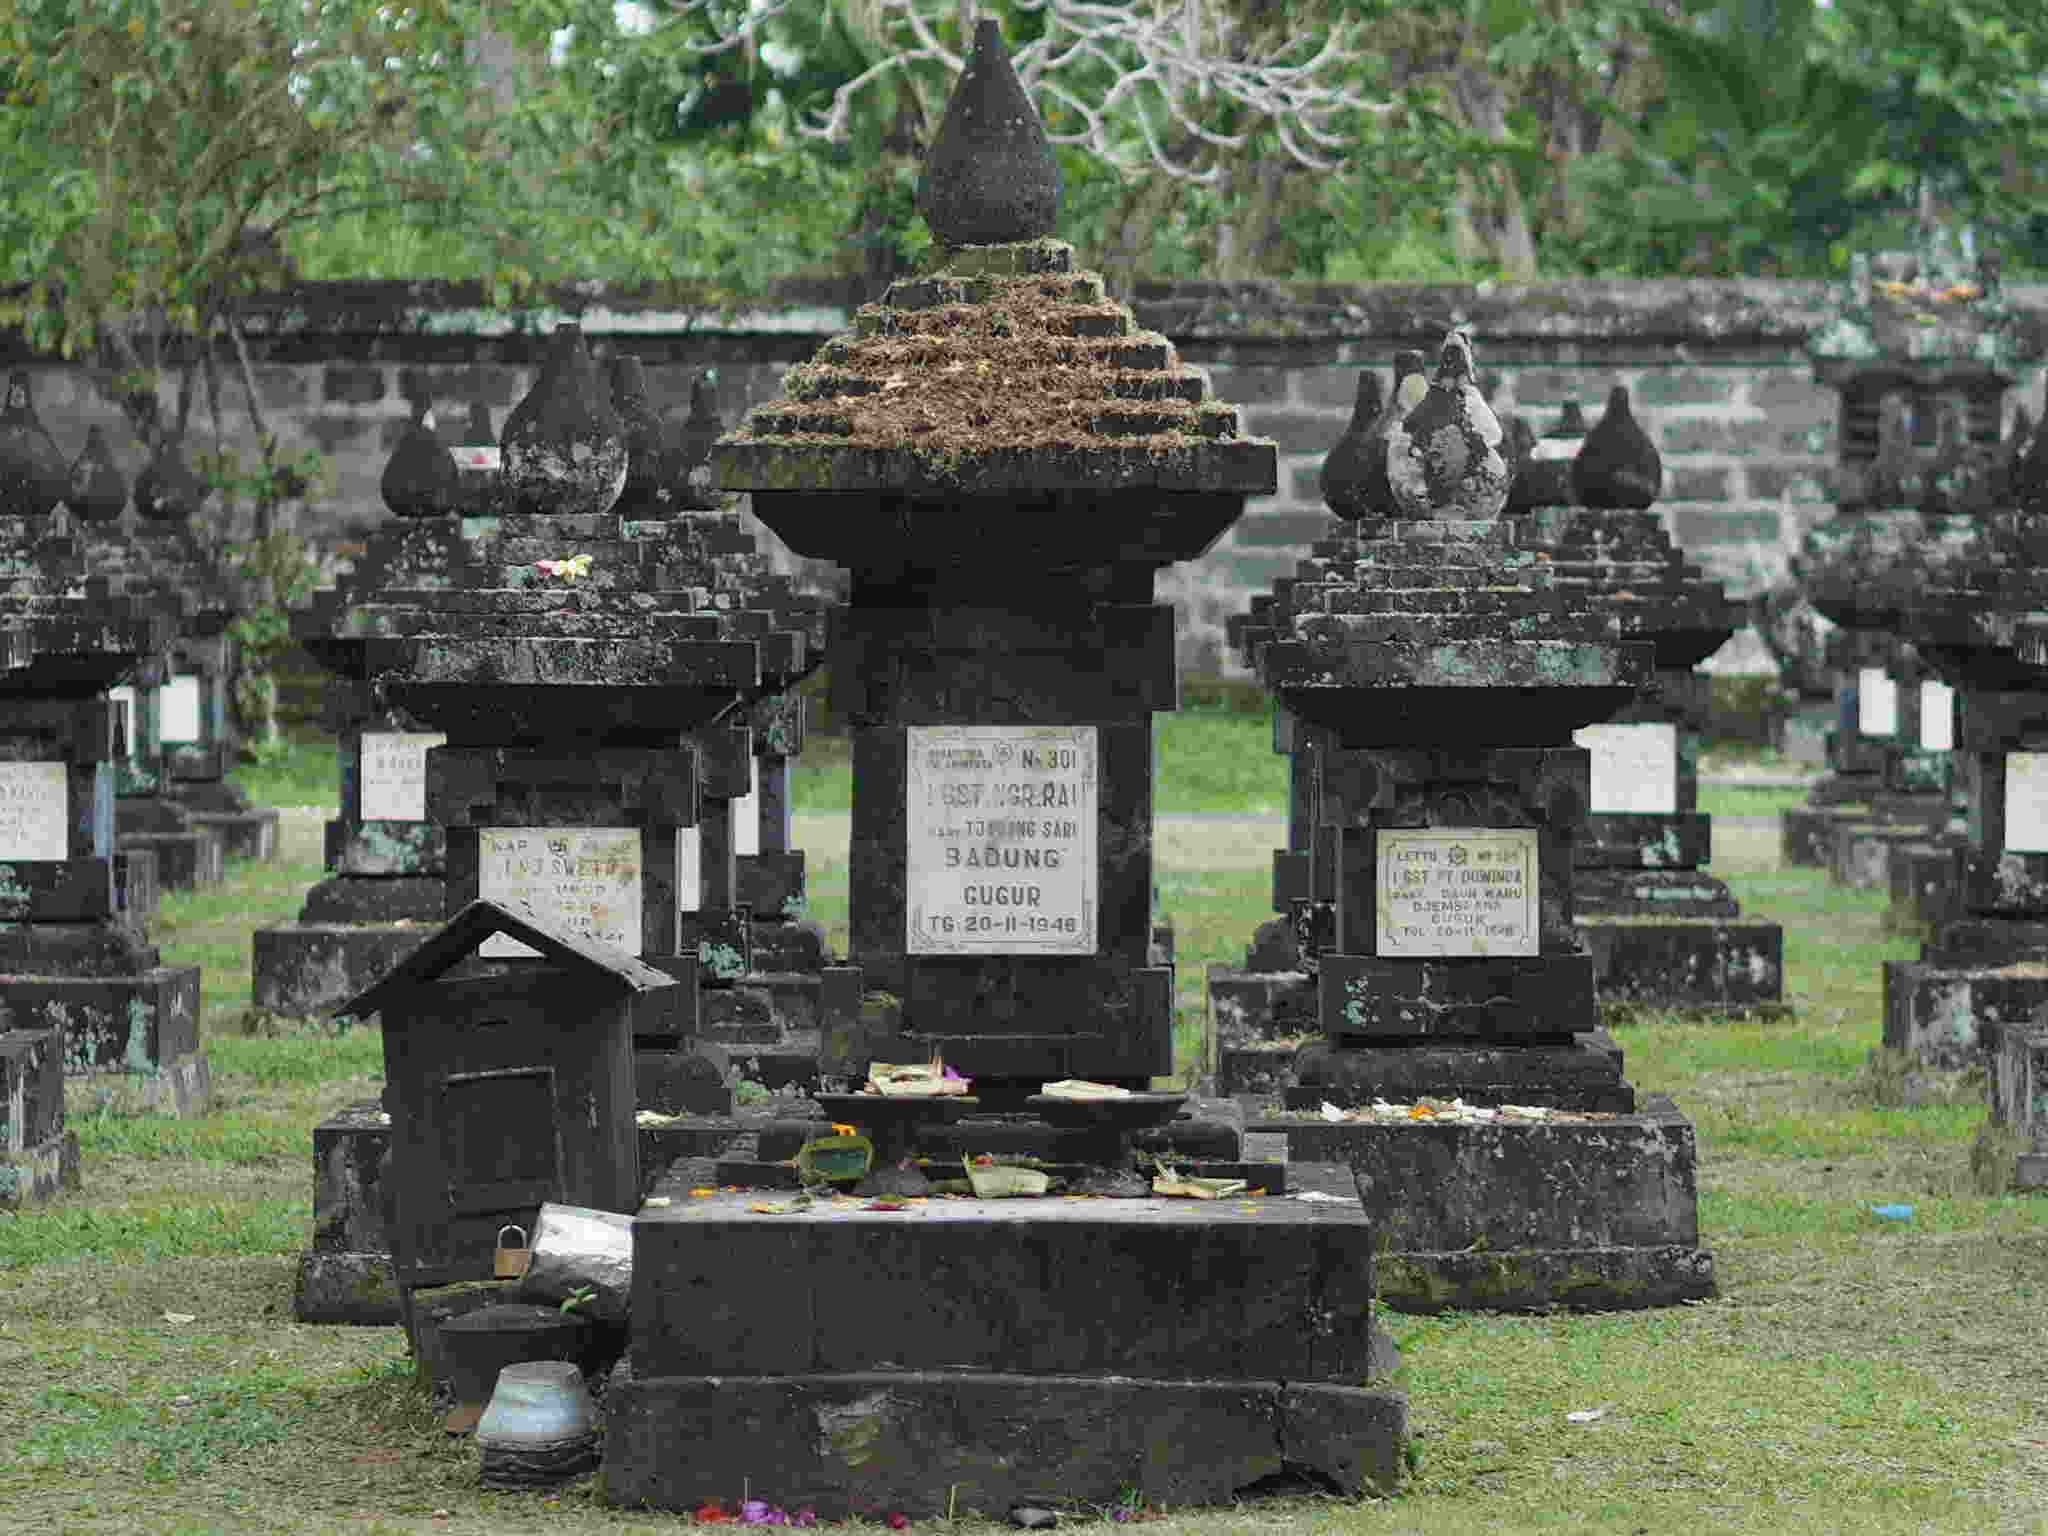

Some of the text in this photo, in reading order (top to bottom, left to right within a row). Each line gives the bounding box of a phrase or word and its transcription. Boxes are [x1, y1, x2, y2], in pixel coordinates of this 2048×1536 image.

[1046, 748, 1077, 769] 301
[944, 846, 1061, 869] BADUNG
[962, 884, 1042, 907] GUGUR
